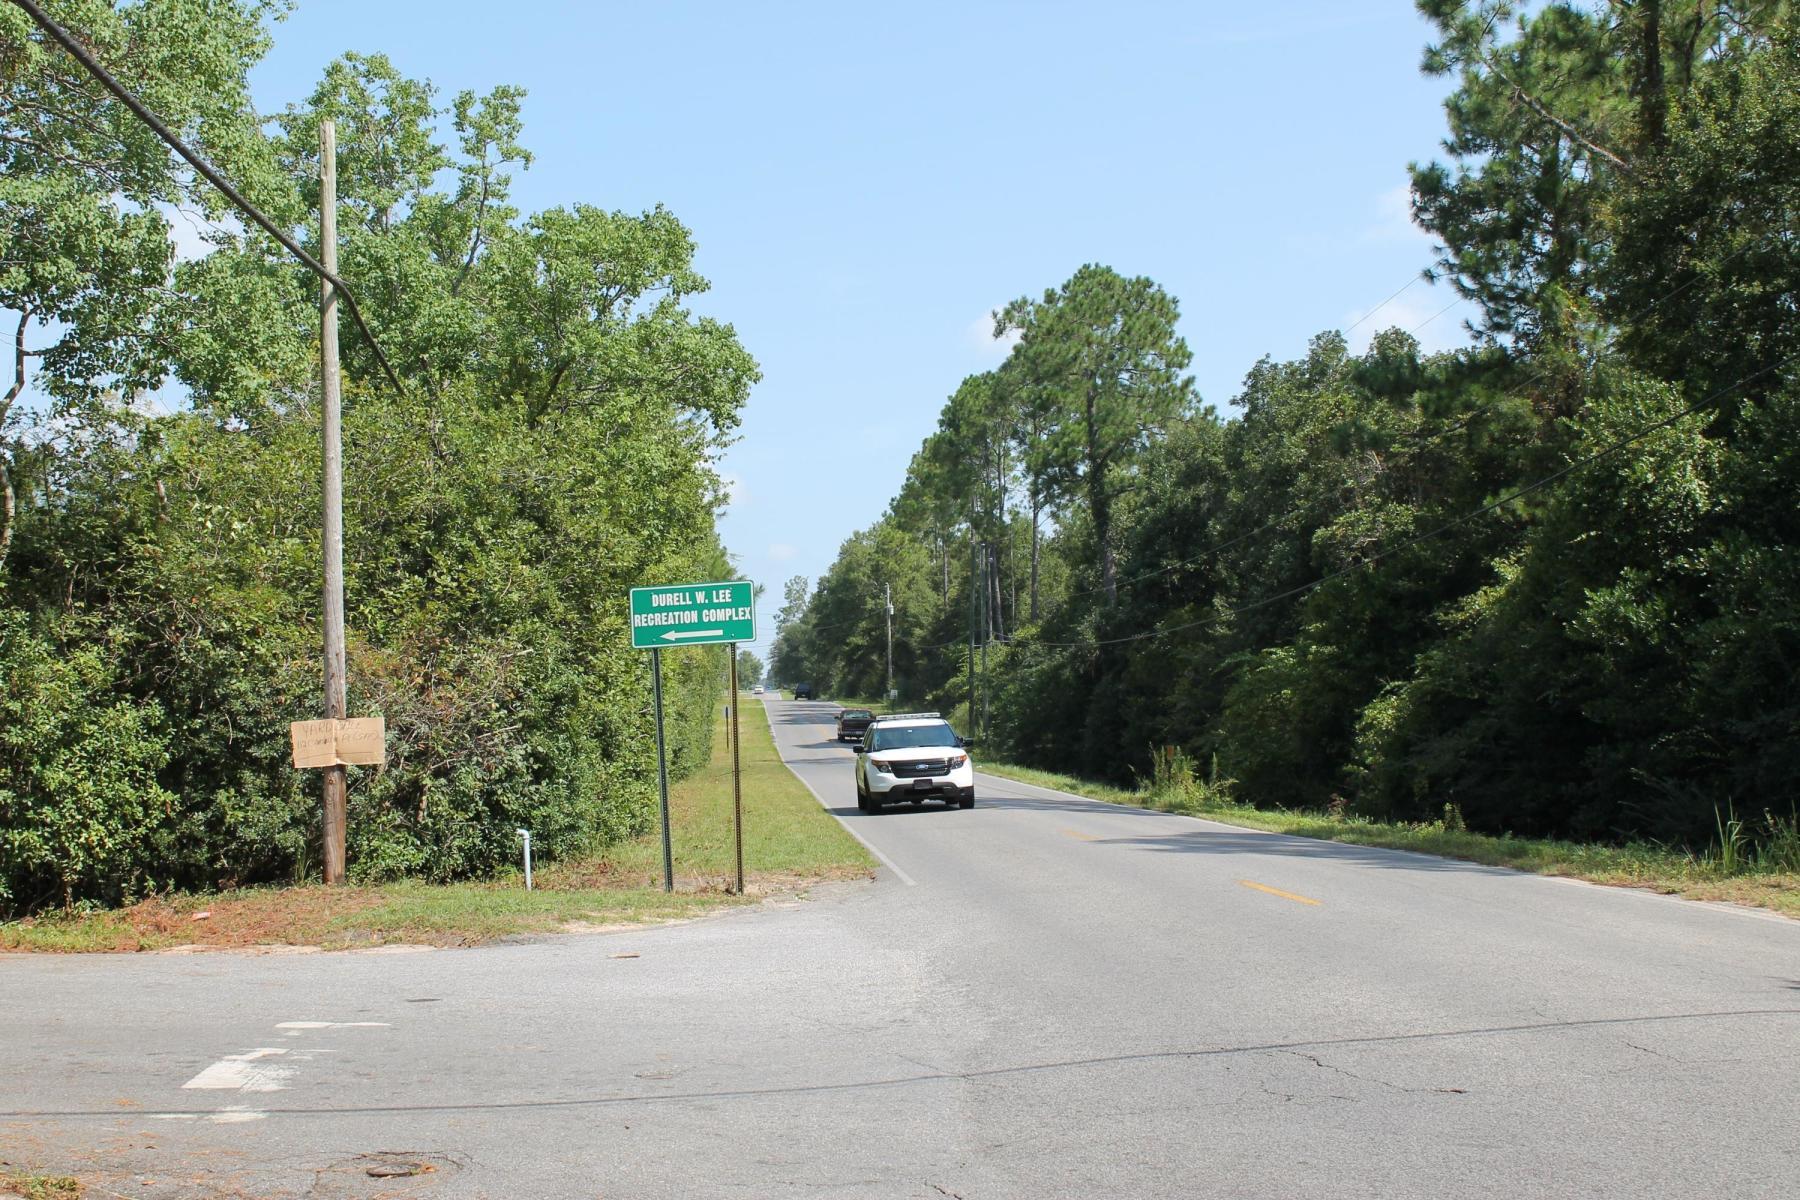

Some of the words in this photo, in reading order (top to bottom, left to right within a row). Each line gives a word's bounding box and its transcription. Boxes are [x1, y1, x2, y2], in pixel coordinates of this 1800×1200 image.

[651, 592, 692, 607] DURELL
[695, 591, 709, 604] W.
[712, 590, 732, 603] LEE
[634, 610, 698, 627] RECREATION
[702, 607, 752, 622] COMPLEX
